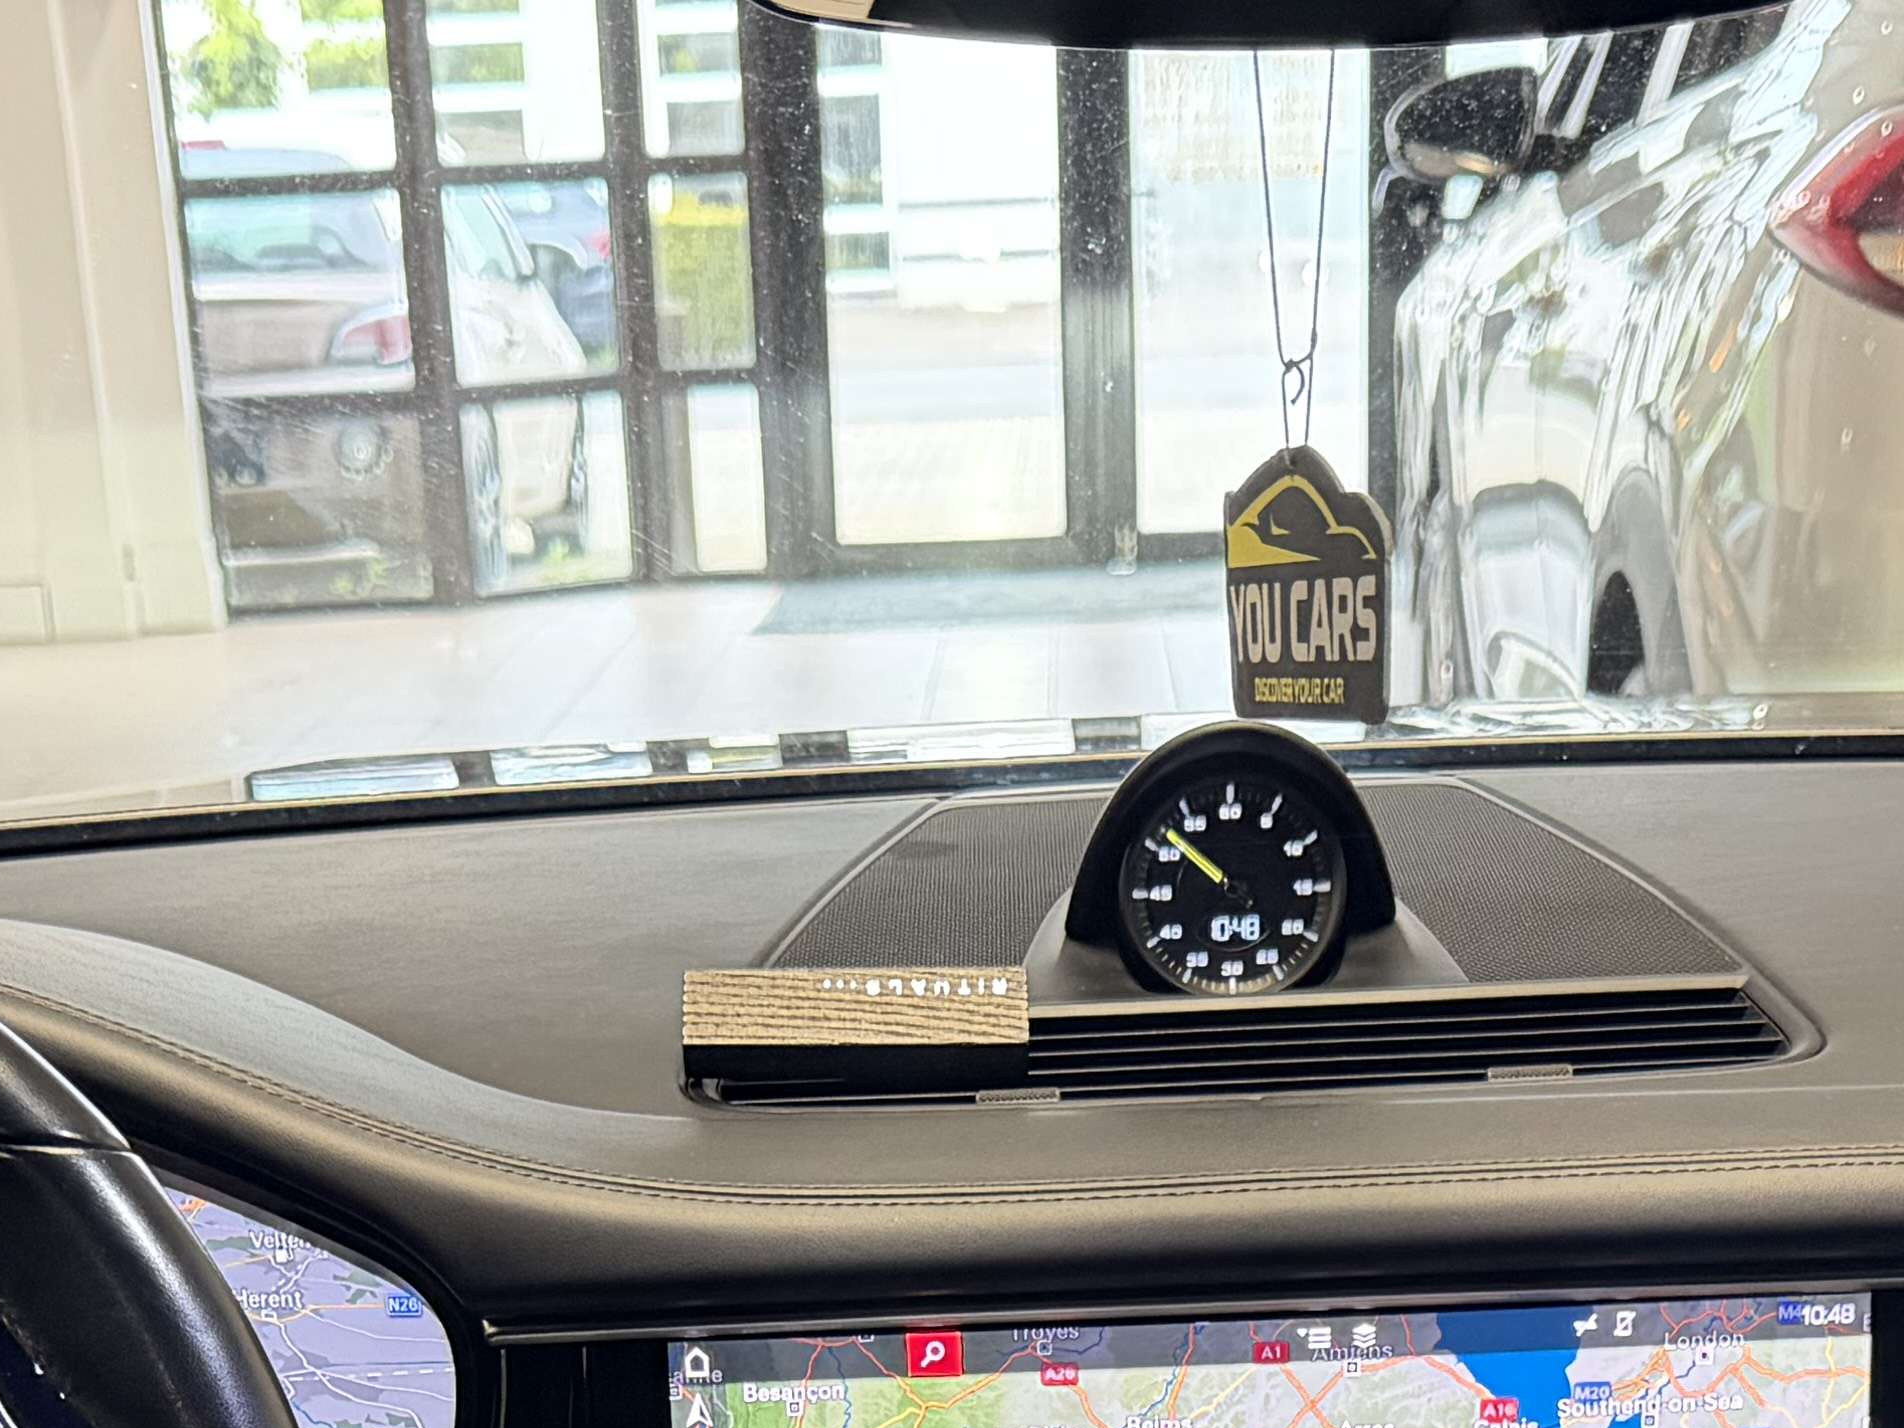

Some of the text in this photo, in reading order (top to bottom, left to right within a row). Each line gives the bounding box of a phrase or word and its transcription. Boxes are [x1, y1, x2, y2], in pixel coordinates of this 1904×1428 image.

[1230, 575, 1377, 664] YOU CARS
[1254, 677, 1345, 704] DISCOVER YOUR CAR
[387, 1296, 419, 1314] N26
[1801, 1302, 1856, 1325] 10:48
[1663, 1331, 1746, 1350] London
[1261, 1345, 1283, 1360] A1
[1311, 1344, 1394, 1362] Amiens
[743, 1382, 845, 1404] Besançon
[1574, 1385, 1611, 1400] M20
